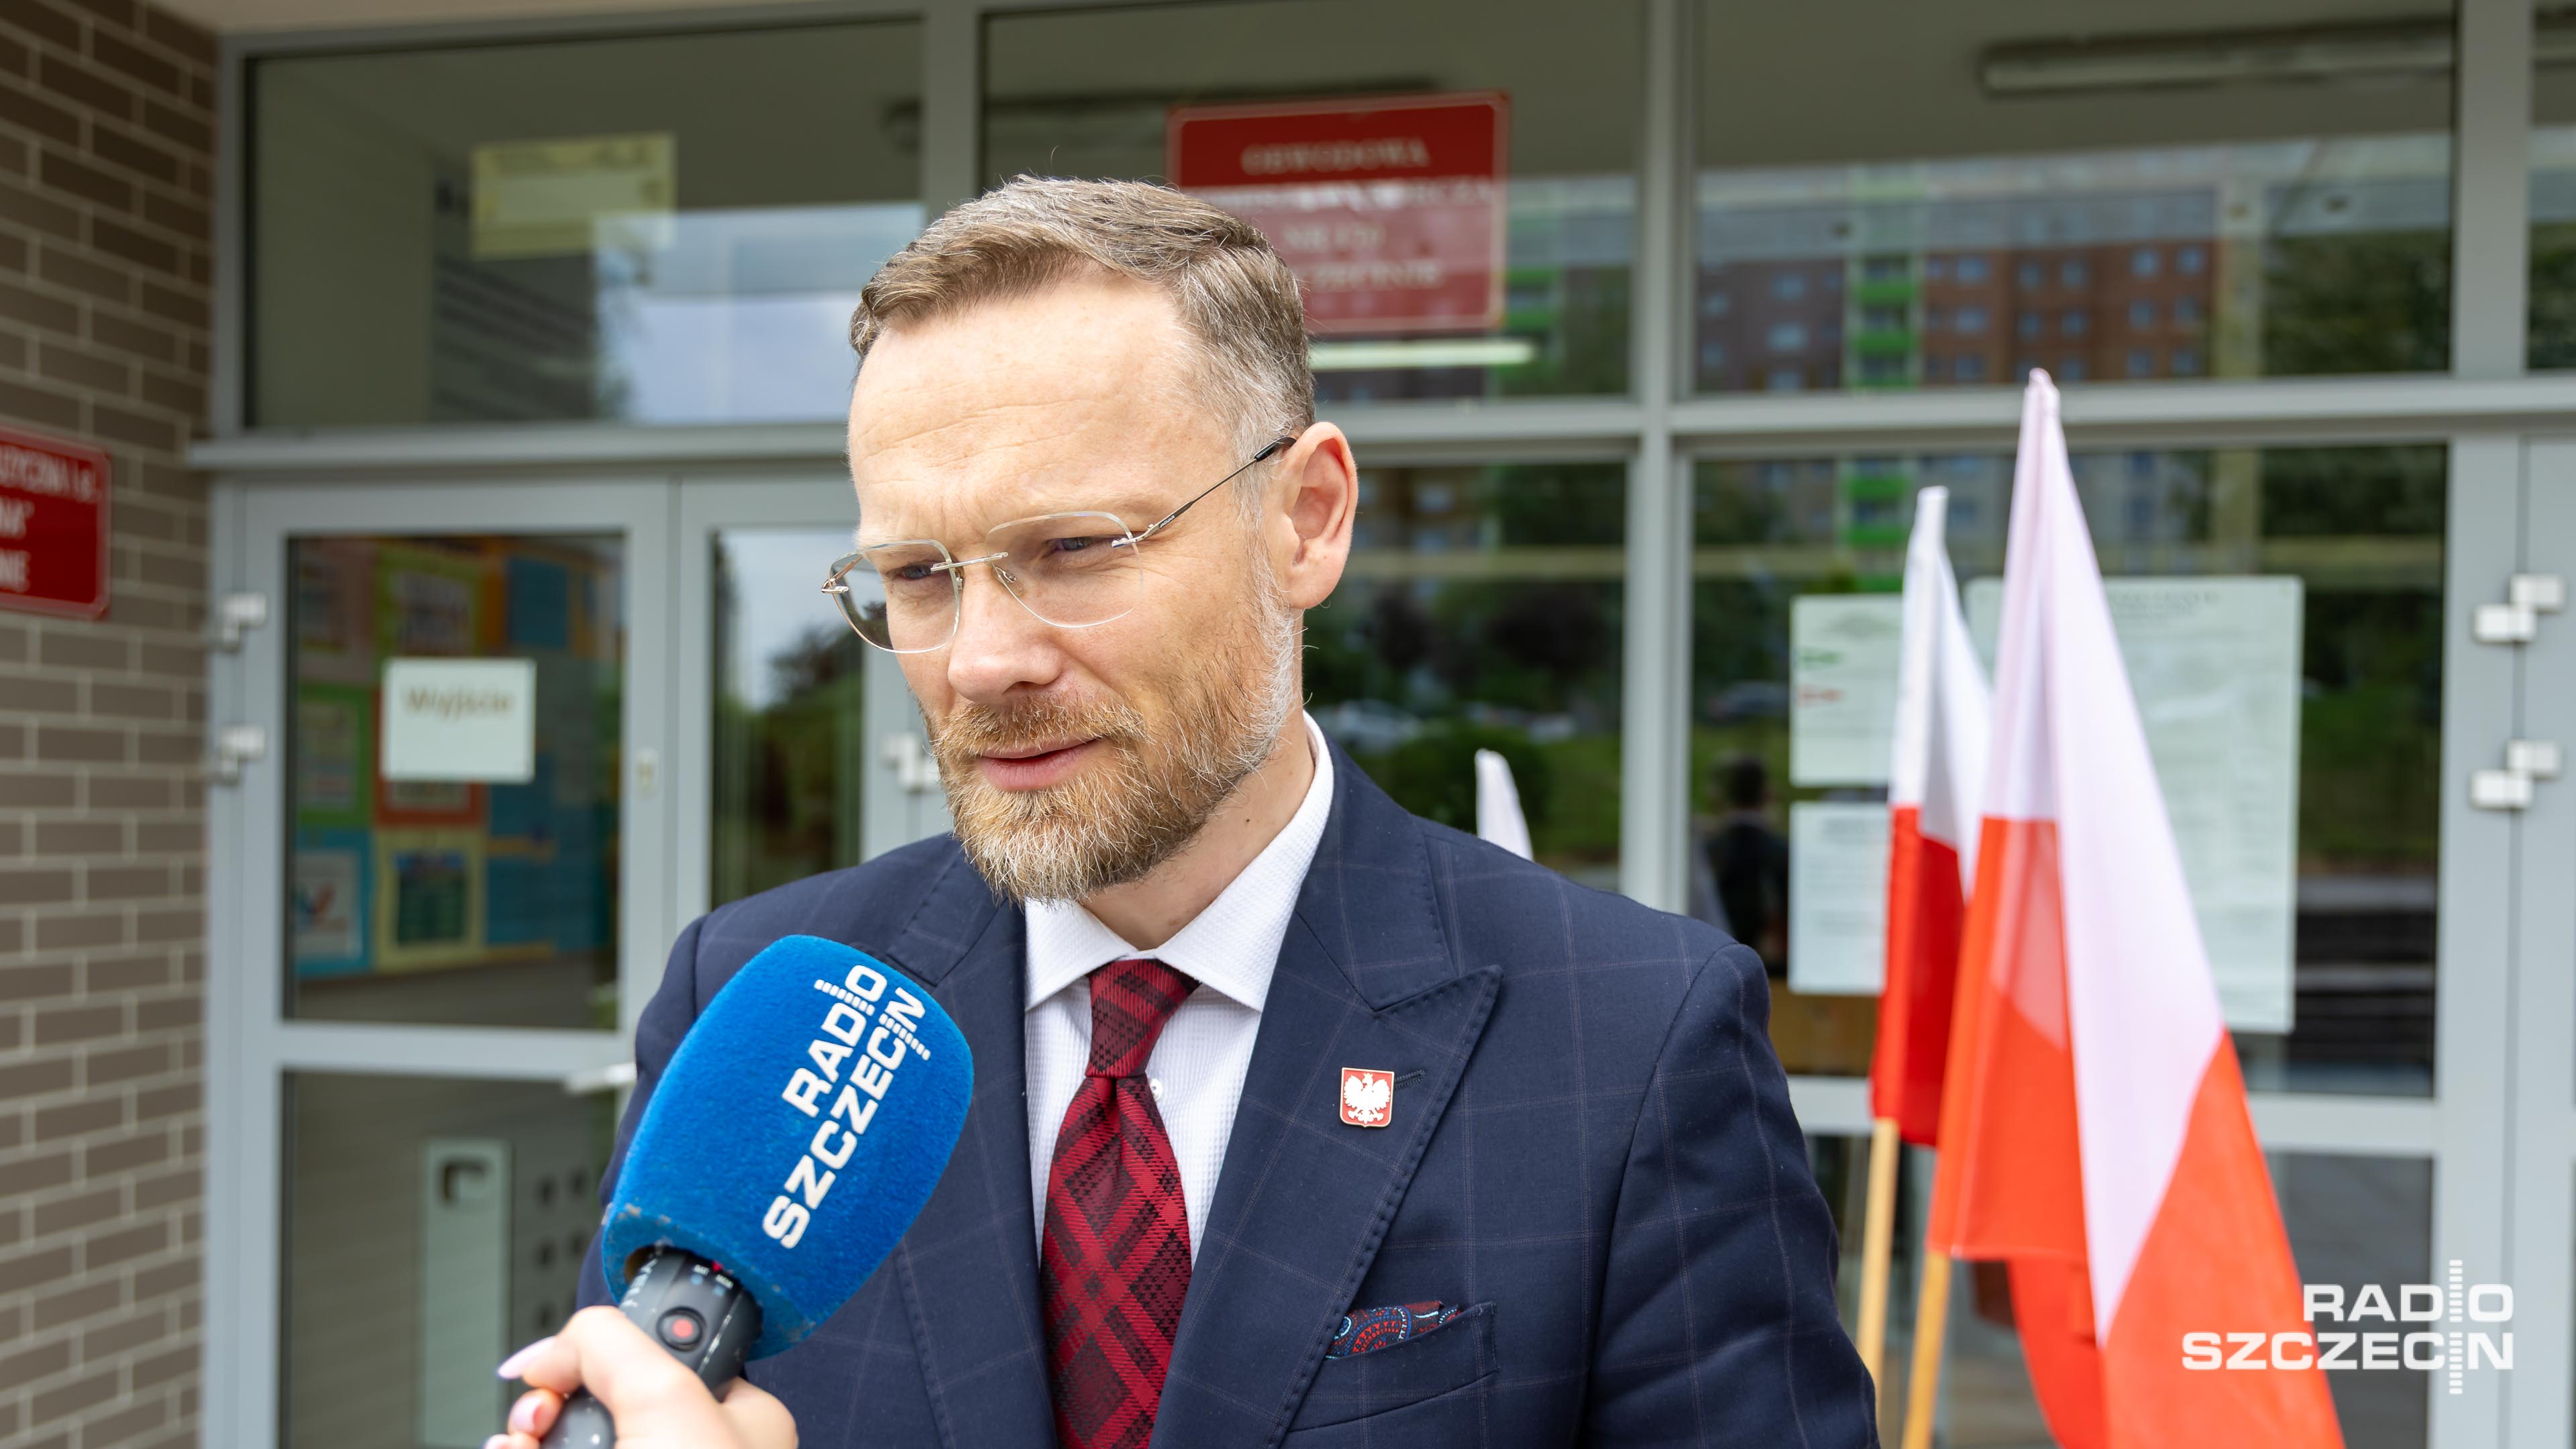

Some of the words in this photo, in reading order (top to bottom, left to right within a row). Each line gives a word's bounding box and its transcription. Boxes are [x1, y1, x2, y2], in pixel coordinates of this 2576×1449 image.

[1160, 515, 1175, 529] JAGUAR
[763, 987, 931, 1249] SZCZECIN
[781, 965, 888, 1118] RADIO
